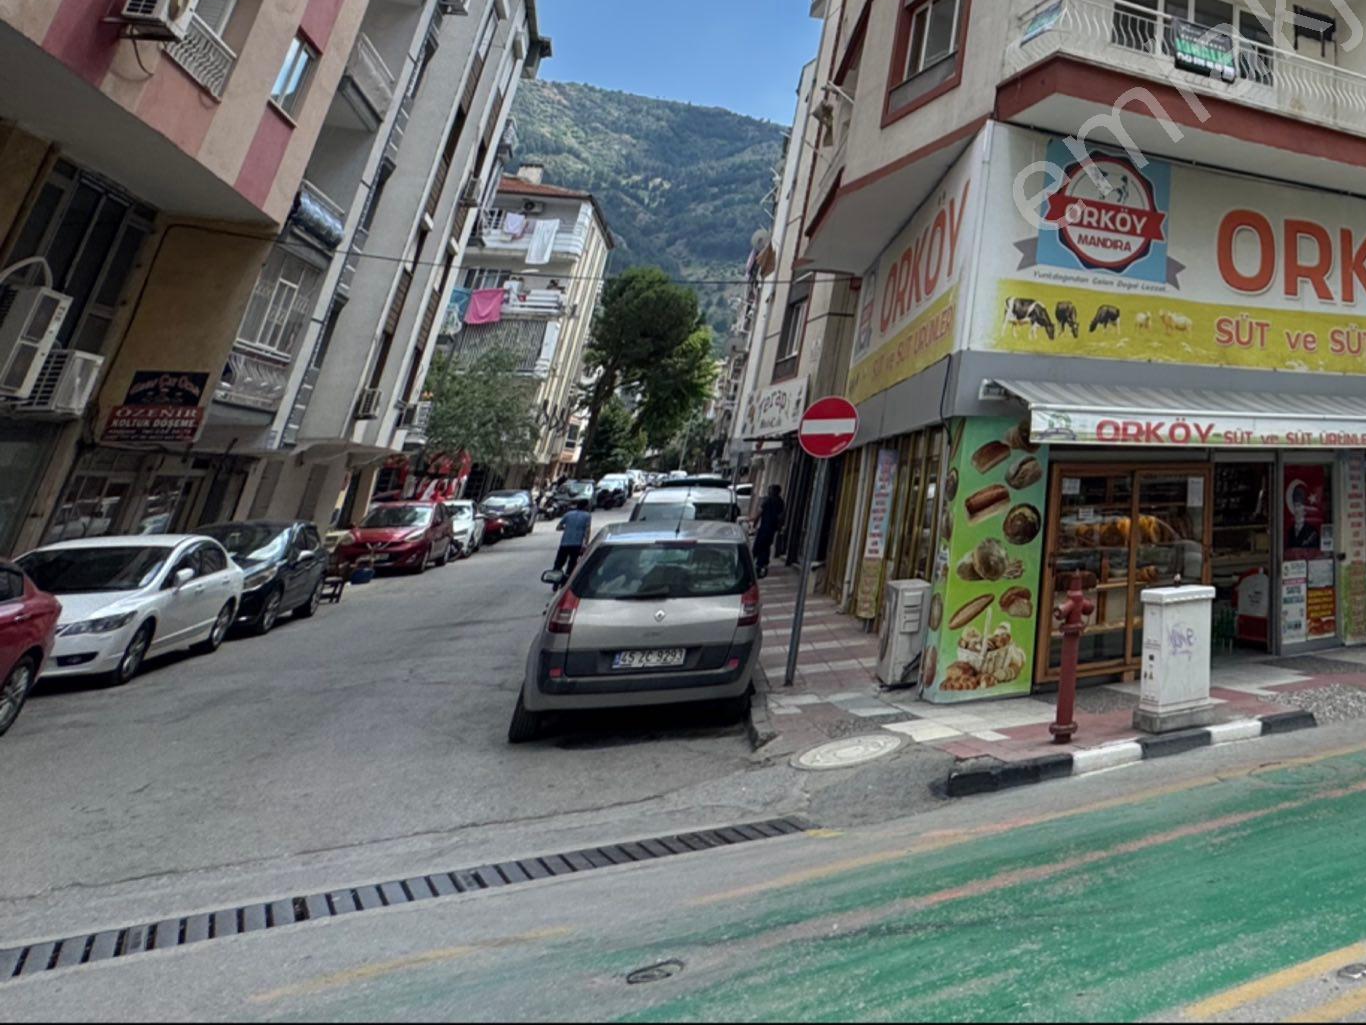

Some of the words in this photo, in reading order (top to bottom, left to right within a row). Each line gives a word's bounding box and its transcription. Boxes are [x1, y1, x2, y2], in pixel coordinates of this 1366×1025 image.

[1065, 204, 1148, 234] ORKÖY
[880, 179, 970, 335] ORKÖY
[1077, 233, 1132, 253] MANDIRA
[1215, 314, 1270, 349] SÜT
[1286, 330, 1318, 352] ve
[1095, 416, 1215, 445] ORKÖY
[1223, 428, 1252, 445] SÜT
[1286, 429, 1312, 446] SÜT
